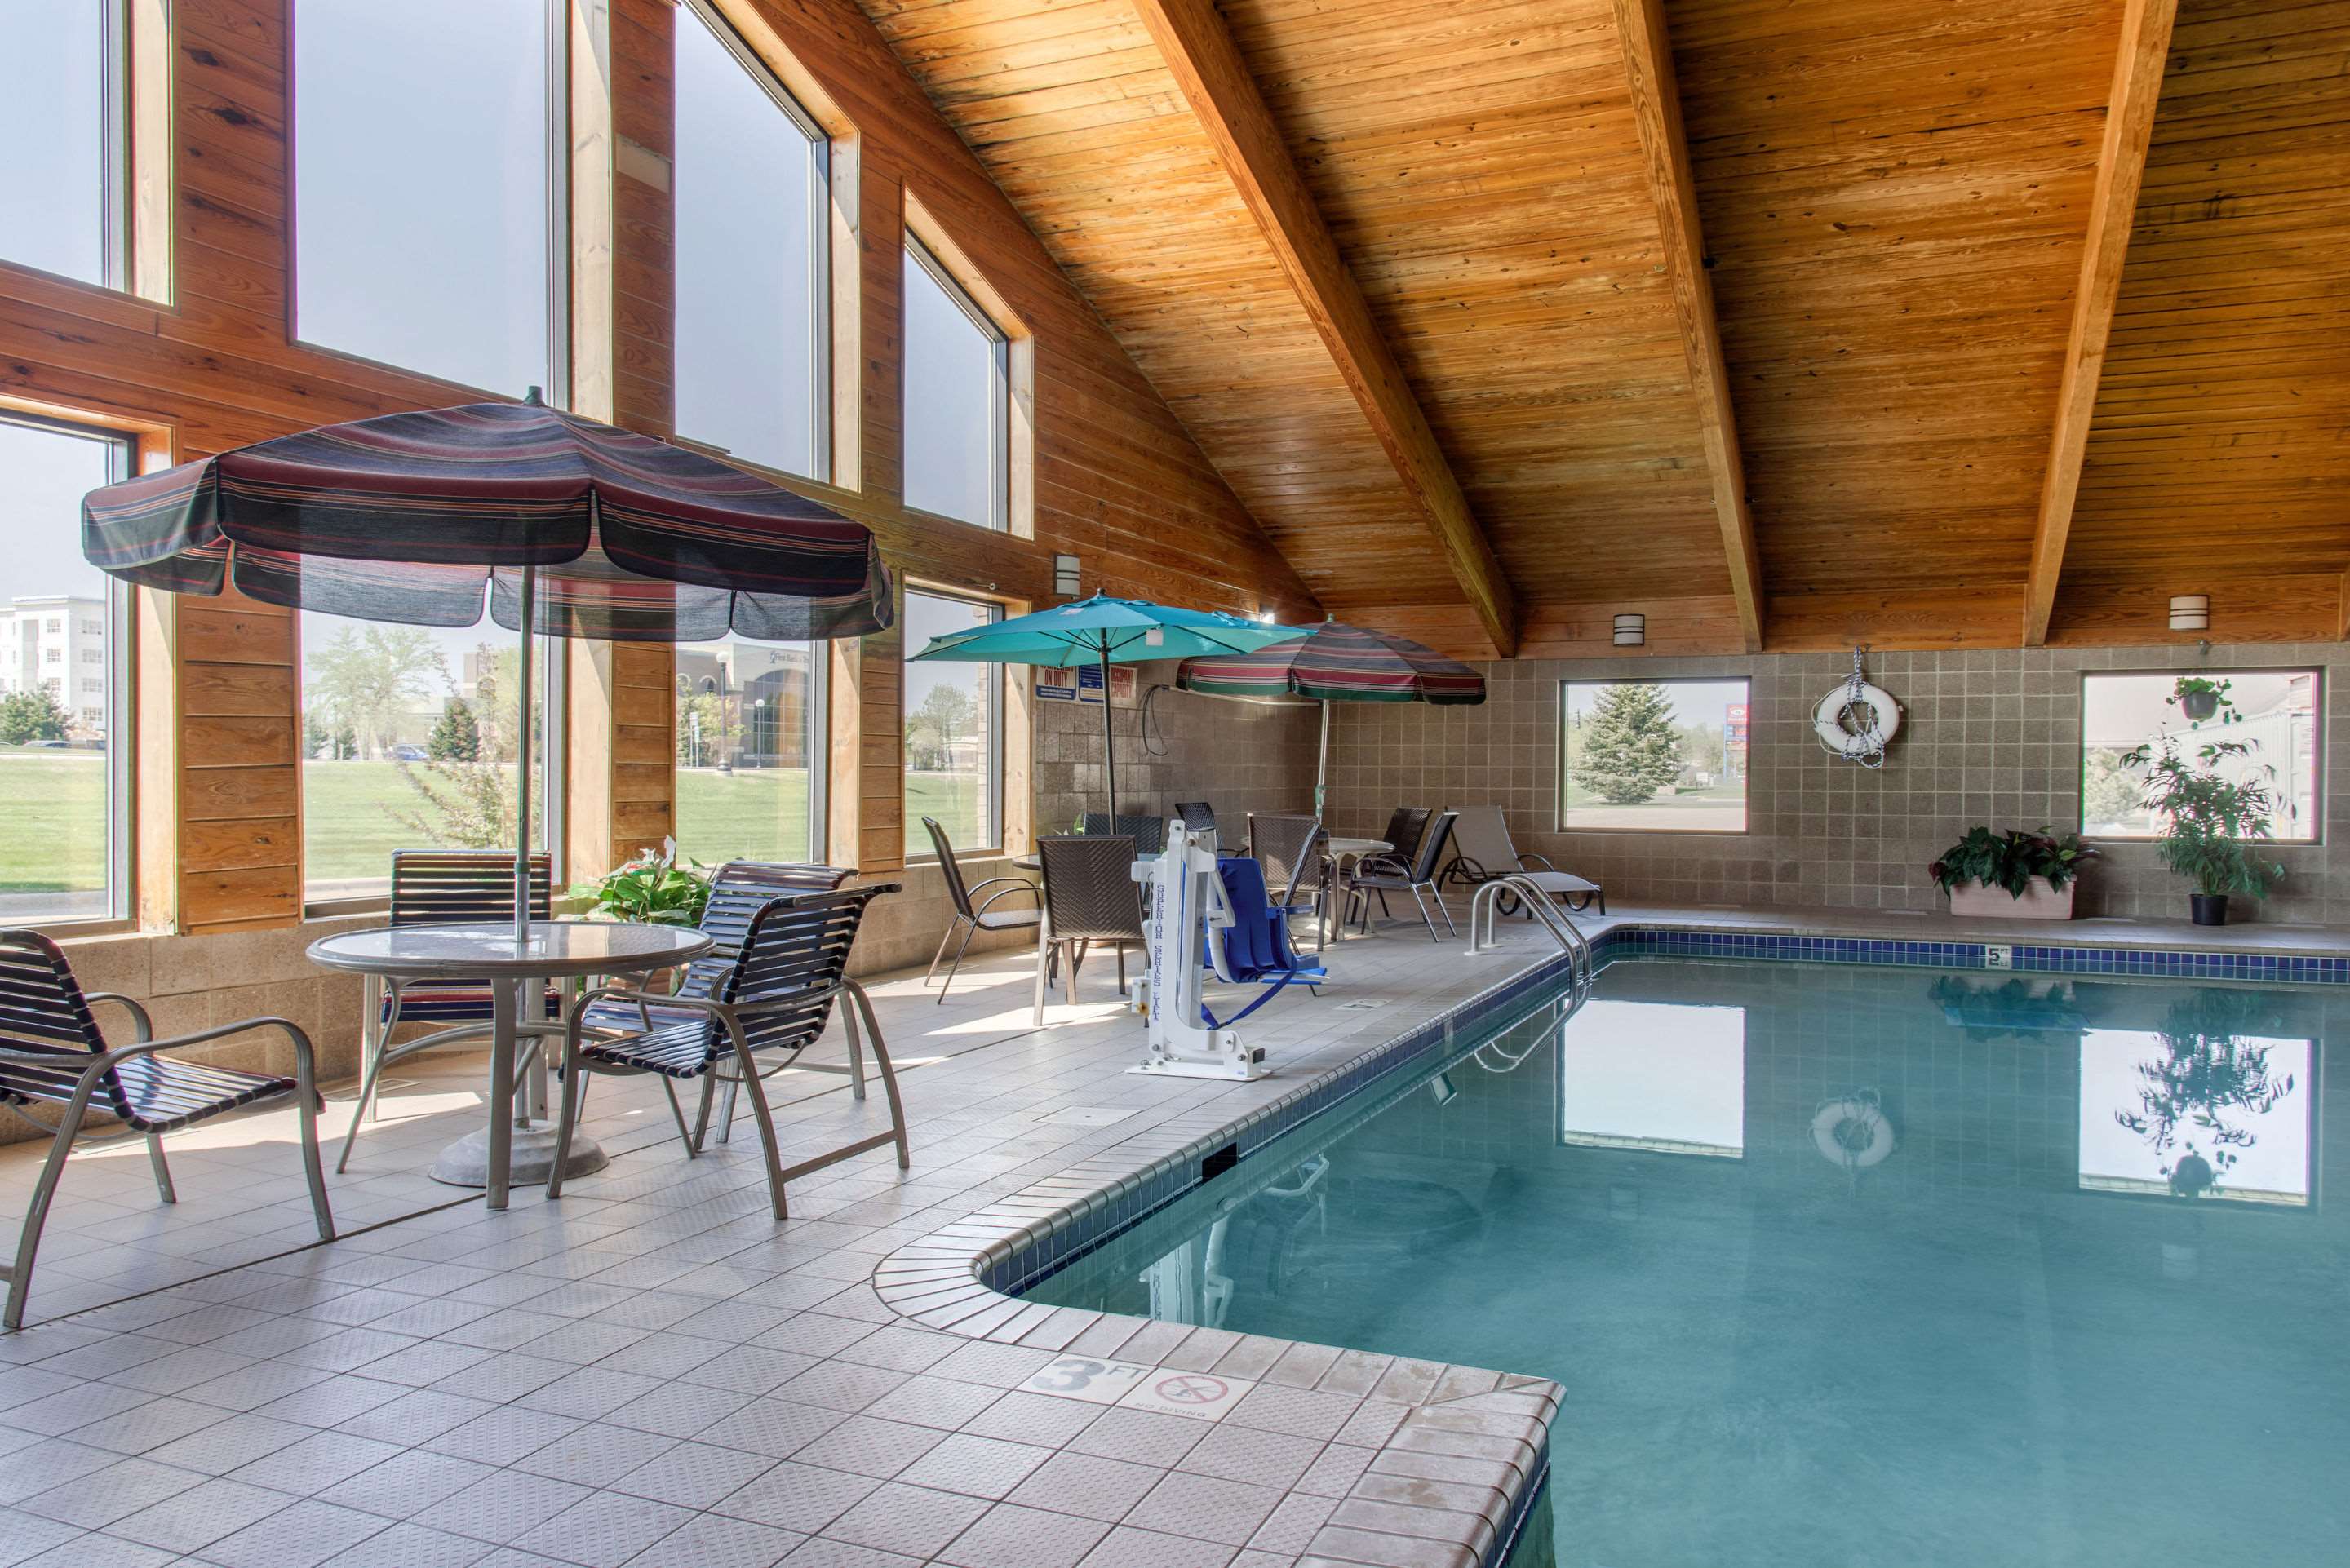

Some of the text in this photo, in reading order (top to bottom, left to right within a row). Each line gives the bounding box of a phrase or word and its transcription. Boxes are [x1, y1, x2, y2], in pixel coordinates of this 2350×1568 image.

[1045, 669, 1052, 685] ON
[1053, 670, 1067, 687] DUTY
[1155, 884, 1164, 939] SUPERIOR
[1153, 945, 1163, 986] SERIES
[1031, 1359, 1149, 1391] 3 FT
[1135, 1402, 1206, 1418] NO DIVING
